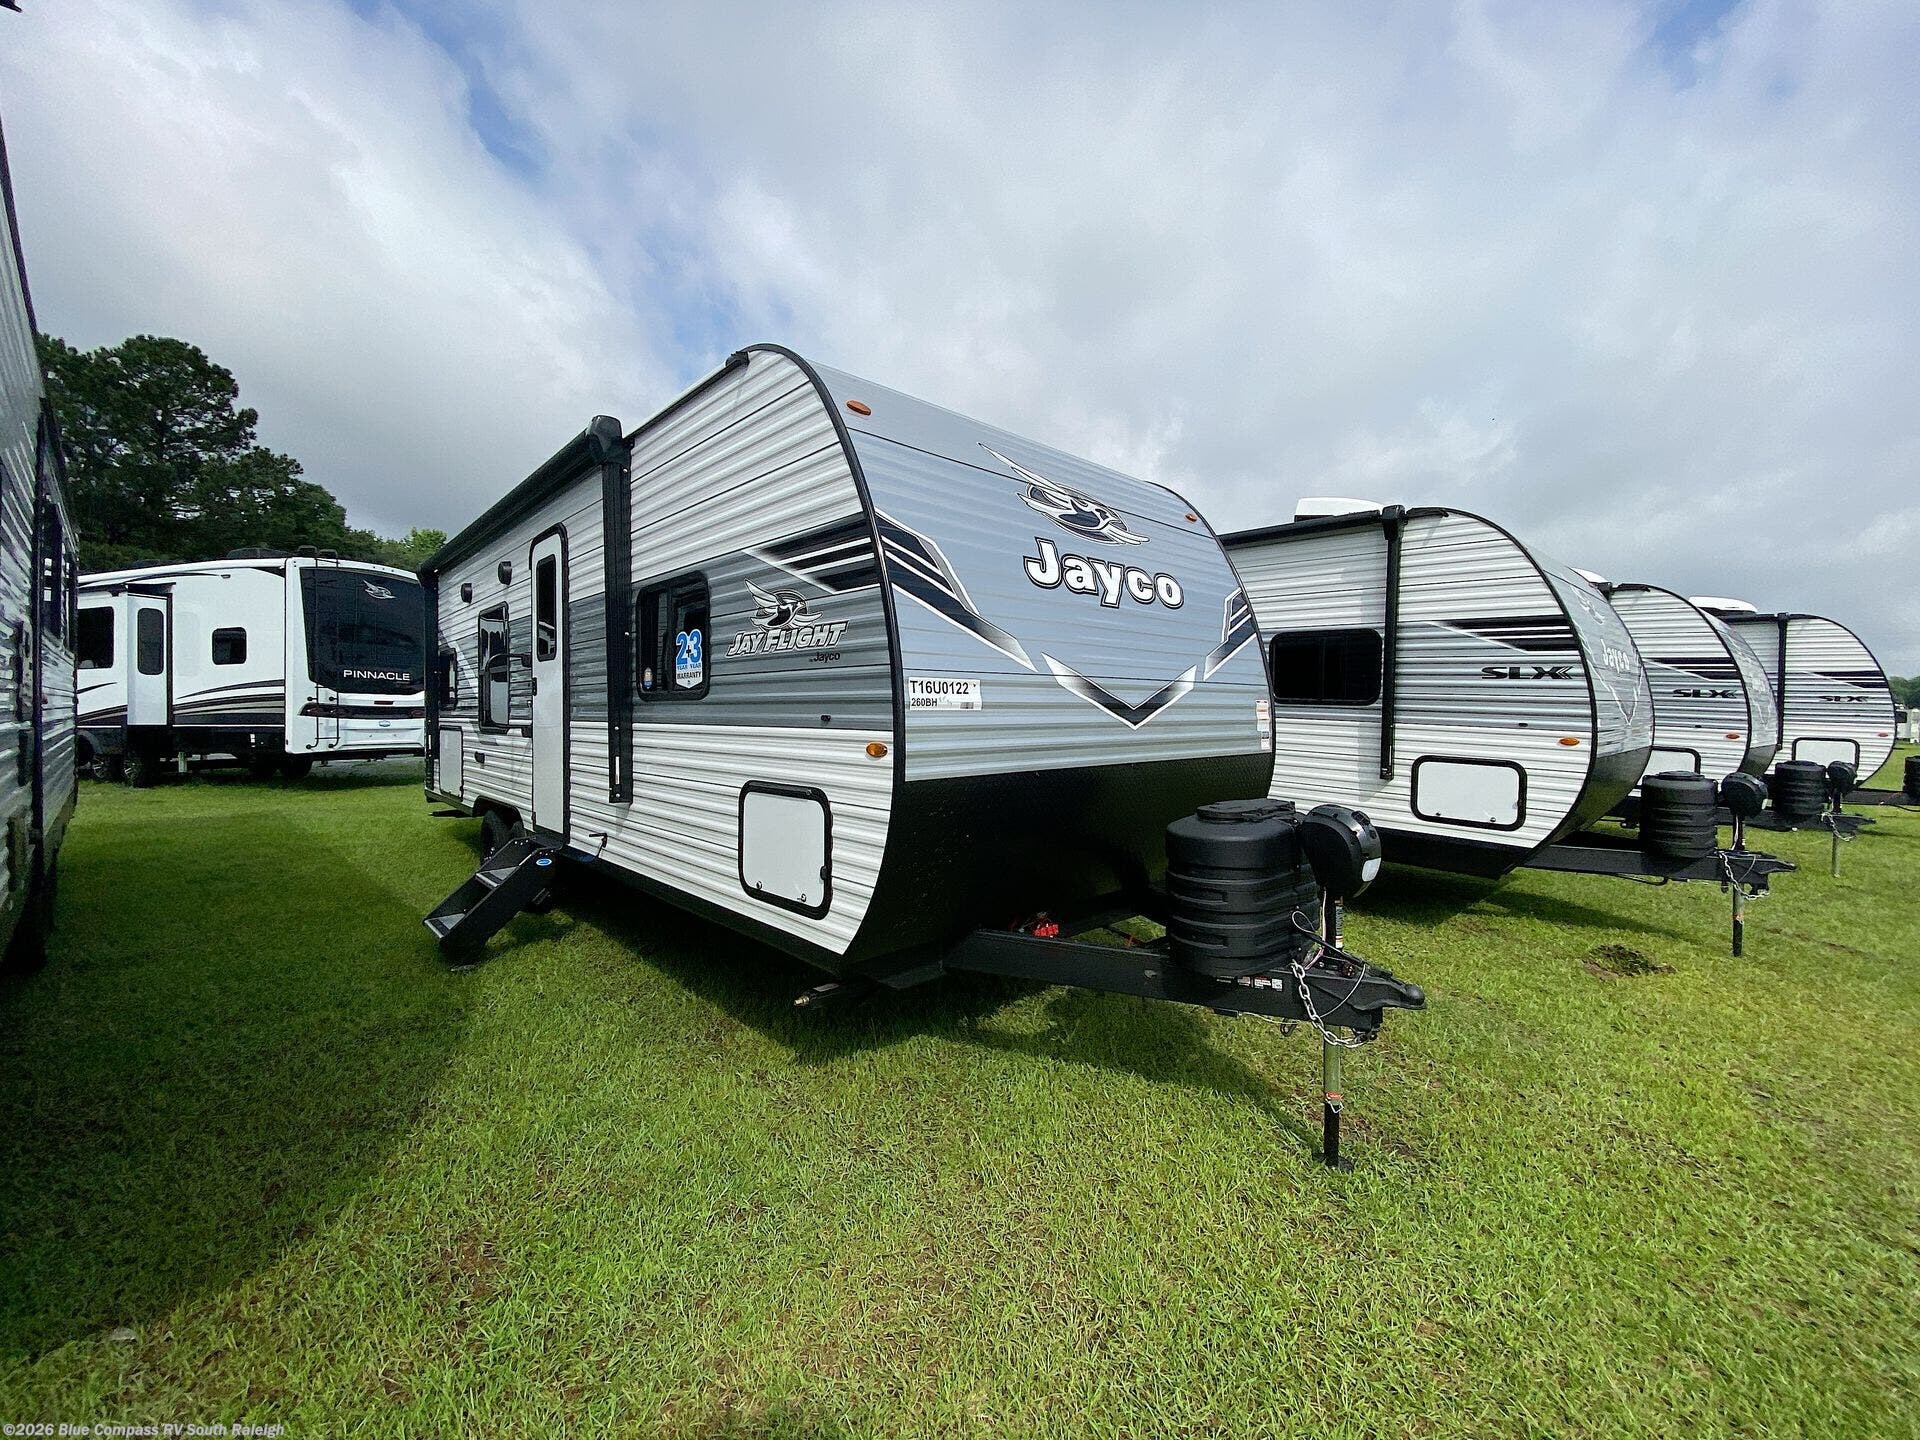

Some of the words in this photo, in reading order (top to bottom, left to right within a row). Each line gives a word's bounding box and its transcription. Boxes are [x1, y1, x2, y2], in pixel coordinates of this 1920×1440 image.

[1023, 536, 1184, 609] Jayco
[726, 631, 765, 658] JAY
[760, 619, 850, 655] FLIGHT
[813, 652, 841, 663] Jayco
[343, 669, 411, 681] PINNACLE
[677, 671, 702, 680] WARRANTY
[1481, 666, 1573, 680] SLX
[909, 680, 969, 695] T16U0122
[1672, 688, 1737, 699] SLX
[911, 697, 938, 707] 260BH
